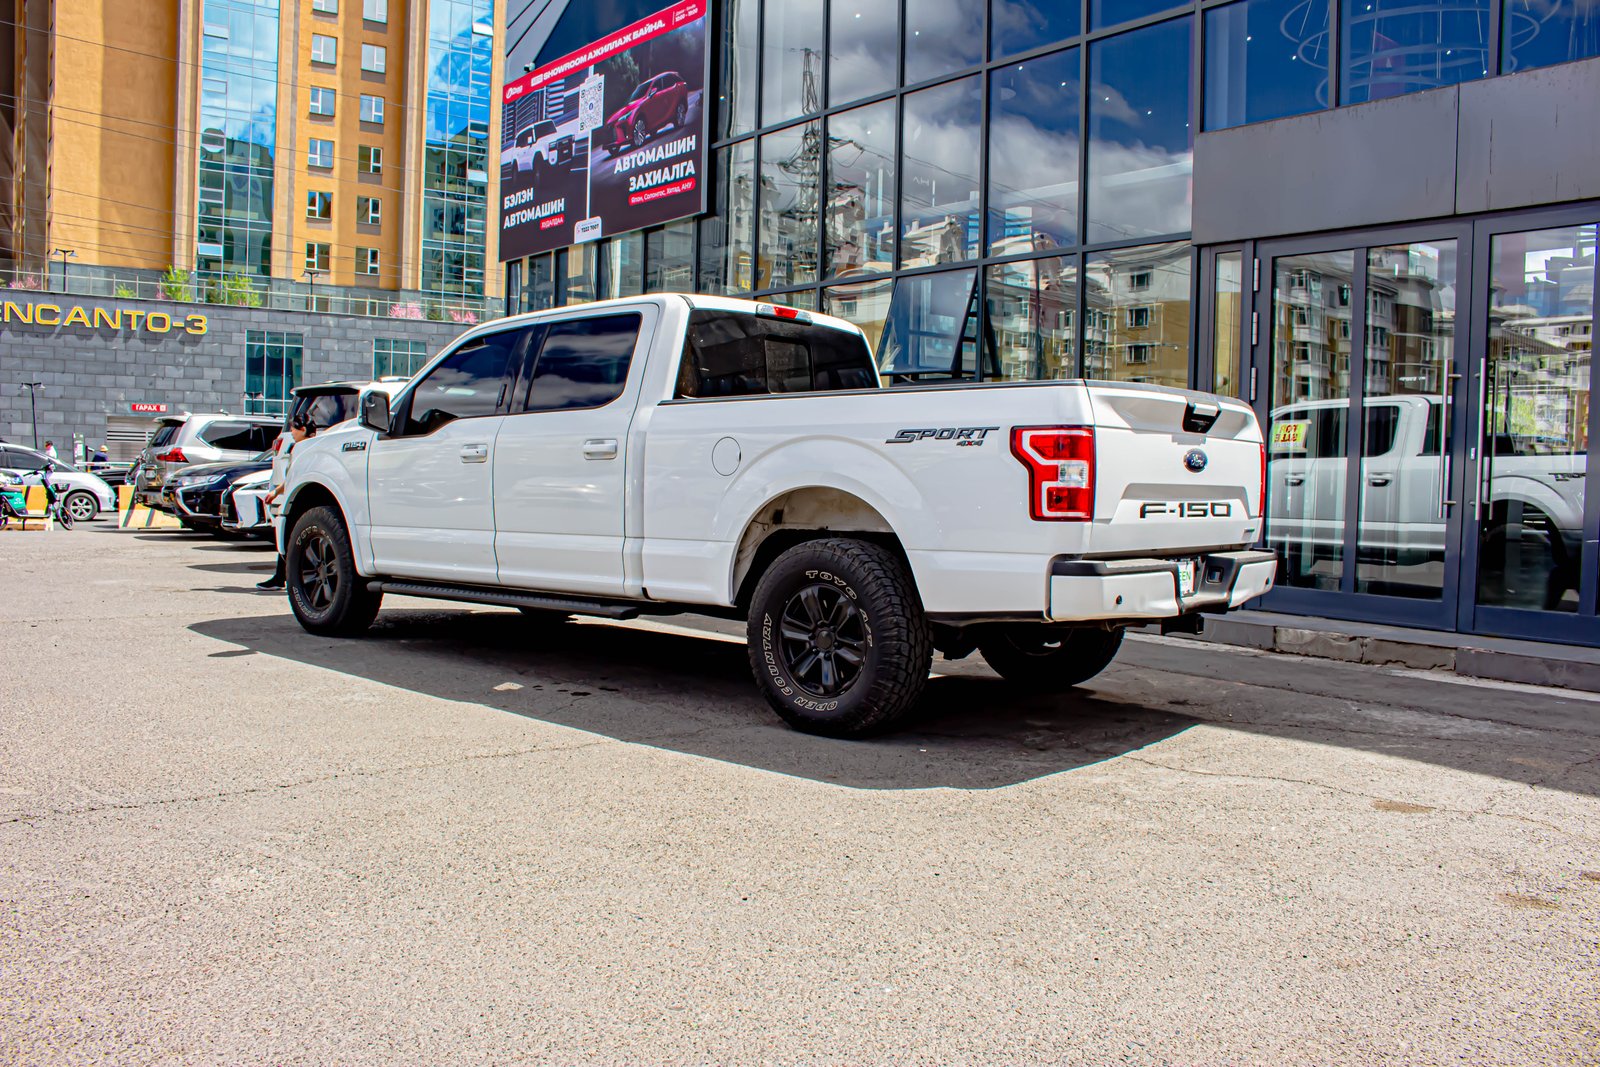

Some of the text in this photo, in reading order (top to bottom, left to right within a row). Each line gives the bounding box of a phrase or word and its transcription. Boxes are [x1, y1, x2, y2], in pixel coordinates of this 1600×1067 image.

[543, 54, 588, 81] SHOWROOM
[613, 134, 697, 175] АВТОМАШИН
[628, 159, 696, 193] ЗАХИАЛГА
[503, 187, 534, 210] БЭЛЭН
[503, 197, 565, 230] АВТОМАШИН
[0, 301, 208, 335] NCANTO-3
[885, 426, 1000, 444] SPORT
[1139, 502, 1232, 519] F-150
[805, 570, 857, 600] TOYO
[762, 612, 838, 711] OPEN COUNTRY
